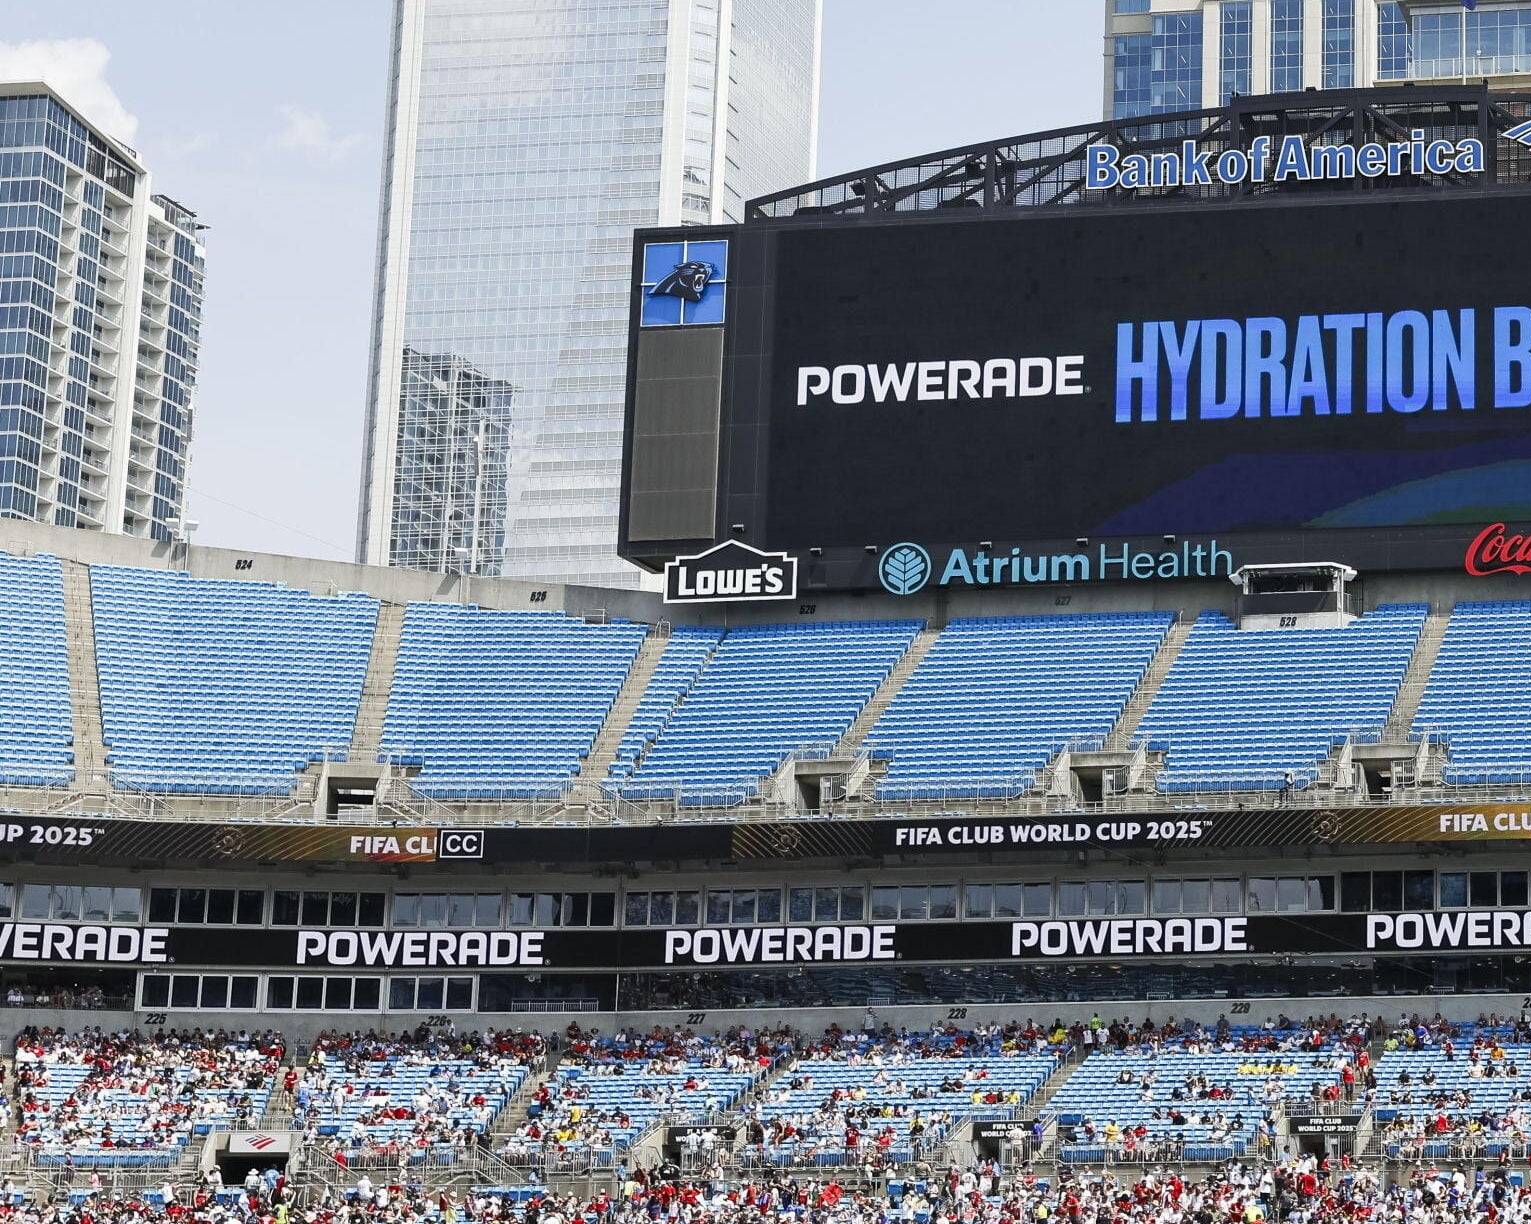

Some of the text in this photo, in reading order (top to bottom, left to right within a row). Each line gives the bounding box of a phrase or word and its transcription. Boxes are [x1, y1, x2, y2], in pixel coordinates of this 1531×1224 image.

[1085, 129, 1485, 189] Bank of America
[1116, 308, 1475, 422] HYDRATION
[235, 558, 253, 571] 524
[939, 540, 1232, 585] Atrium Health
[678, 564, 783, 596] LOWE'S
[529, 590, 547, 603] 525
[1279, 616, 1297, 627] 528
[1440, 814, 1489, 832] FIFA
[896, 827, 942, 845] FIFA
[948, 826, 1004, 844] CLUB
[1010, 824, 1091, 843] WORLD
[1097, 822, 1141, 841] CUP
[350, 836, 437, 854] FIFA CL
[446, 835, 477, 853] CC
[948, 1008, 967, 1020] 228
[1231, 1002, 1250, 1015] 229
[144, 1013, 166, 1025] 225
[687, 1013, 705, 1026] 227
